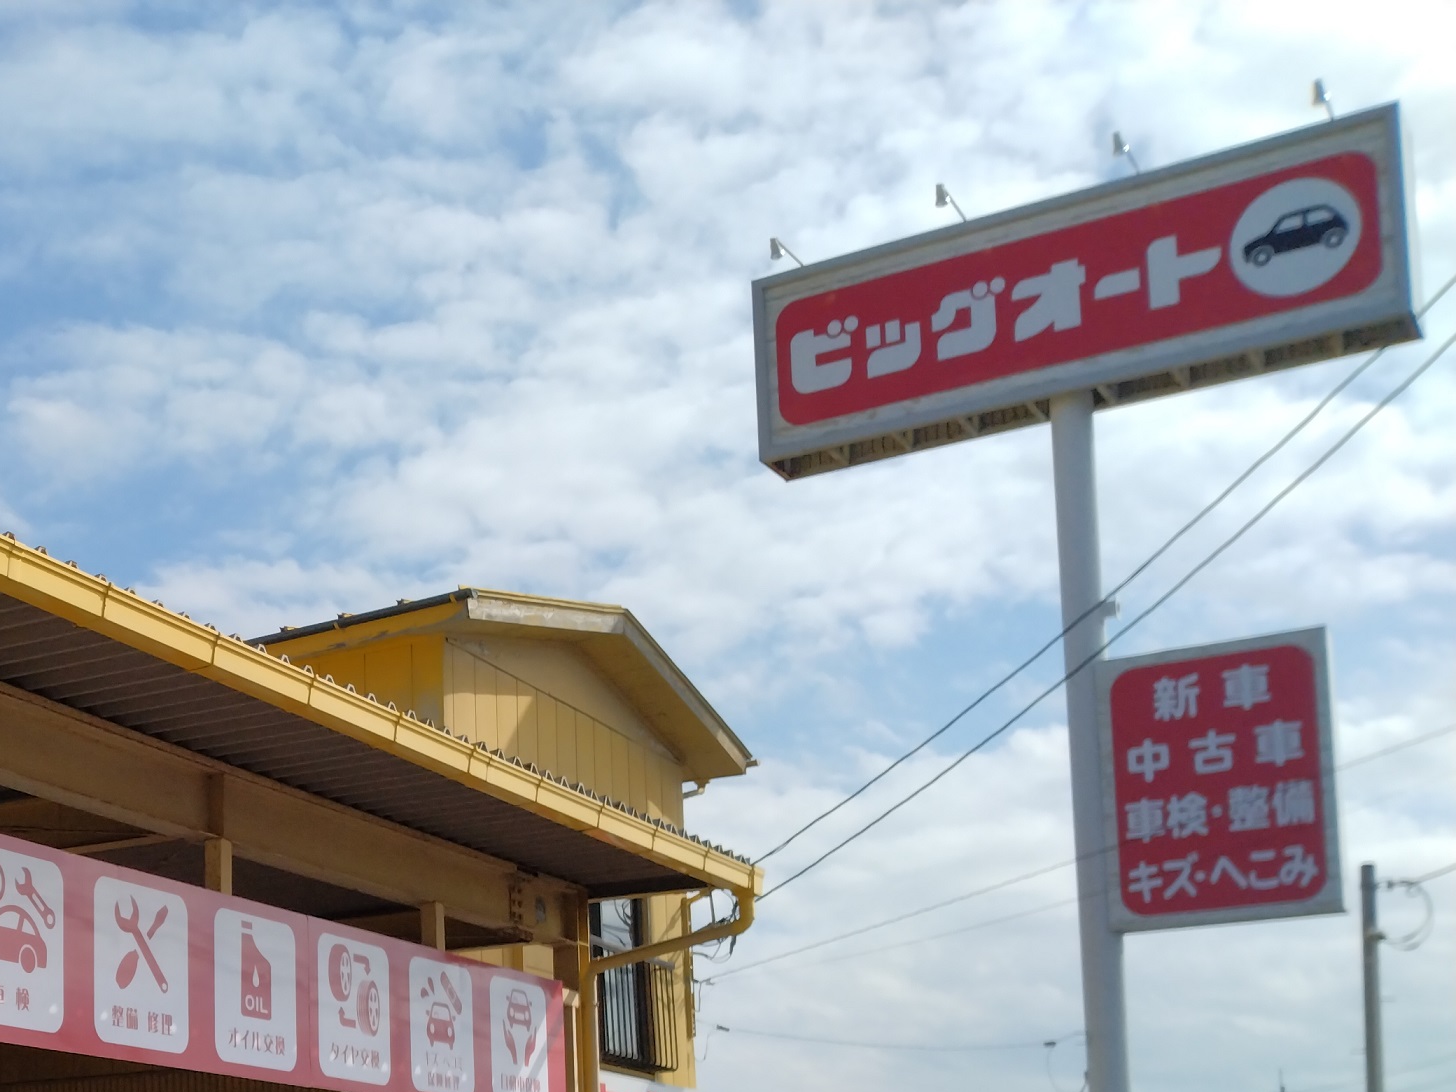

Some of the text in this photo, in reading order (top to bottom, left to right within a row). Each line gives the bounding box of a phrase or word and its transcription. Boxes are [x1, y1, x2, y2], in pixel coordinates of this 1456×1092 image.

[790, 233, 1222, 395] ビッグオート
[1152, 663, 1272, 722] 新車
[1126, 719, 1304, 783] 中古車
[1124, 779, 1316, 844] 車検・整備
[1127, 844, 1319, 904] キズ・へこみ
[245, 994, 269, 1014] OIL
[228, 1027, 286, 1057] オイル交換
[330, 1041, 380, 1070] タイヤ交換
